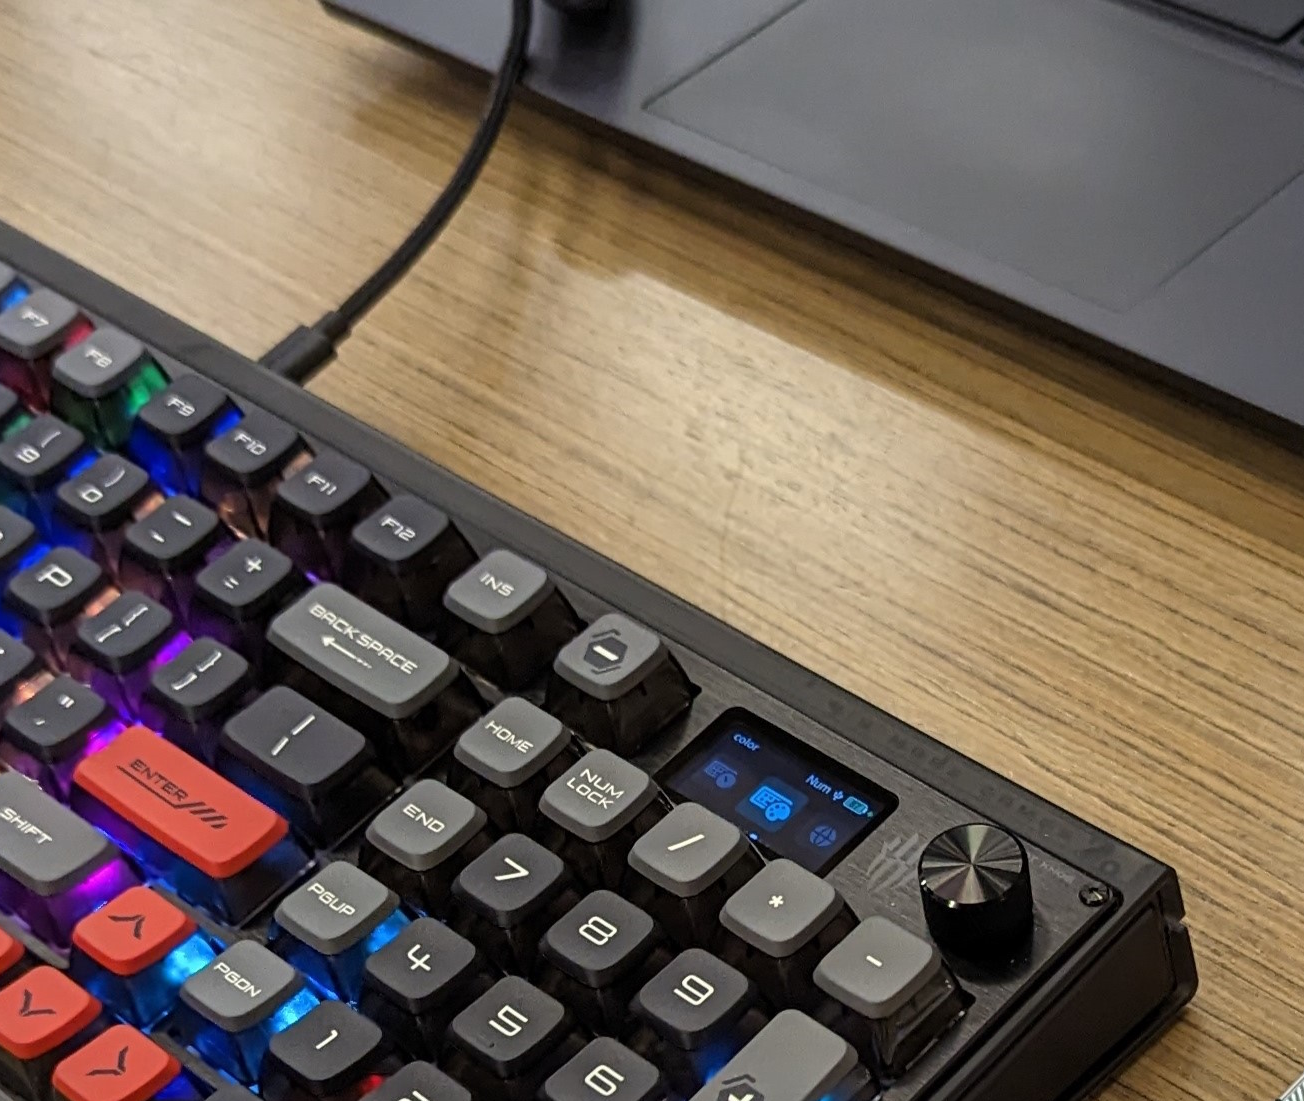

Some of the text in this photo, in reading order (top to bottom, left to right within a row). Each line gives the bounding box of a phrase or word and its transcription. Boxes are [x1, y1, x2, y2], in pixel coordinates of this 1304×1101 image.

[21, 310, 49, 329] F7
[85, 349, 113, 368] F8
[167, 396, 195, 417] F9
[17, 447, 40, 464] 9
[234, 433, 267, 456] F10
[81, 487, 104, 504] 0
[306, 474, 337, 495] F11
[380, 516, 416, 542] F12
[36, 564, 72, 587] P
[480, 573, 514, 597] INS
[309, 604, 417, 674] BACKSPACE
[485, 720, 533, 753] HOME
[733, 733, 760, 751] color
[130, 759, 189, 801] ENTER
[580, 768, 624, 799] NUM
[806, 773, 832, 795] Num
[567, 777, 613, 809] LOCK
[403, 803, 445, 833] END
[667, 834, 705, 851] /
[494, 857, 529, 881] 7
[307, 882, 356, 917] PGUP
[579, 916, 617, 946] 8
[407, 944, 432, 972] 4
[213, 962, 261, 997] PGDN
[674, 974, 715, 1005] 9
[489, 1005, 528, 1036] 5
[315, 1029, 338, 1050] 1
[584, 1064, 625, 1096] 6
